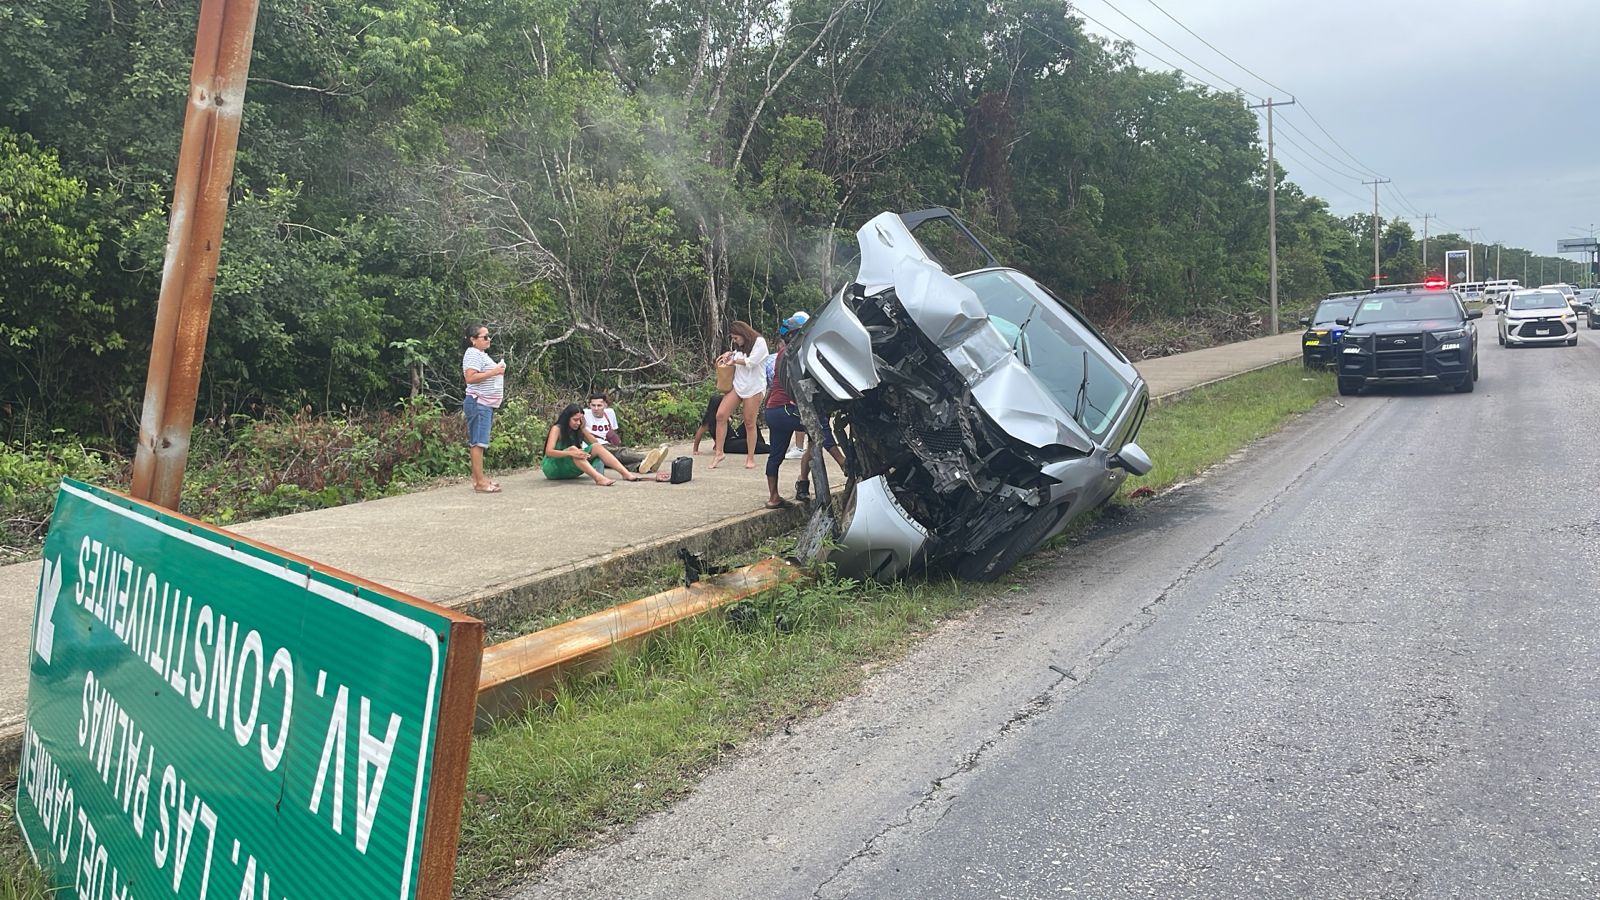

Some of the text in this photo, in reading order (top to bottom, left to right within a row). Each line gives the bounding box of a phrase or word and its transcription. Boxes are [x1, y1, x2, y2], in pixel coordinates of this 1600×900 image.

[22, 721, 74, 864] CARMEN
[76, 536, 402, 854] AV. CONSTITUYENTES
[79, 670, 218, 900] LAS PALMAS
